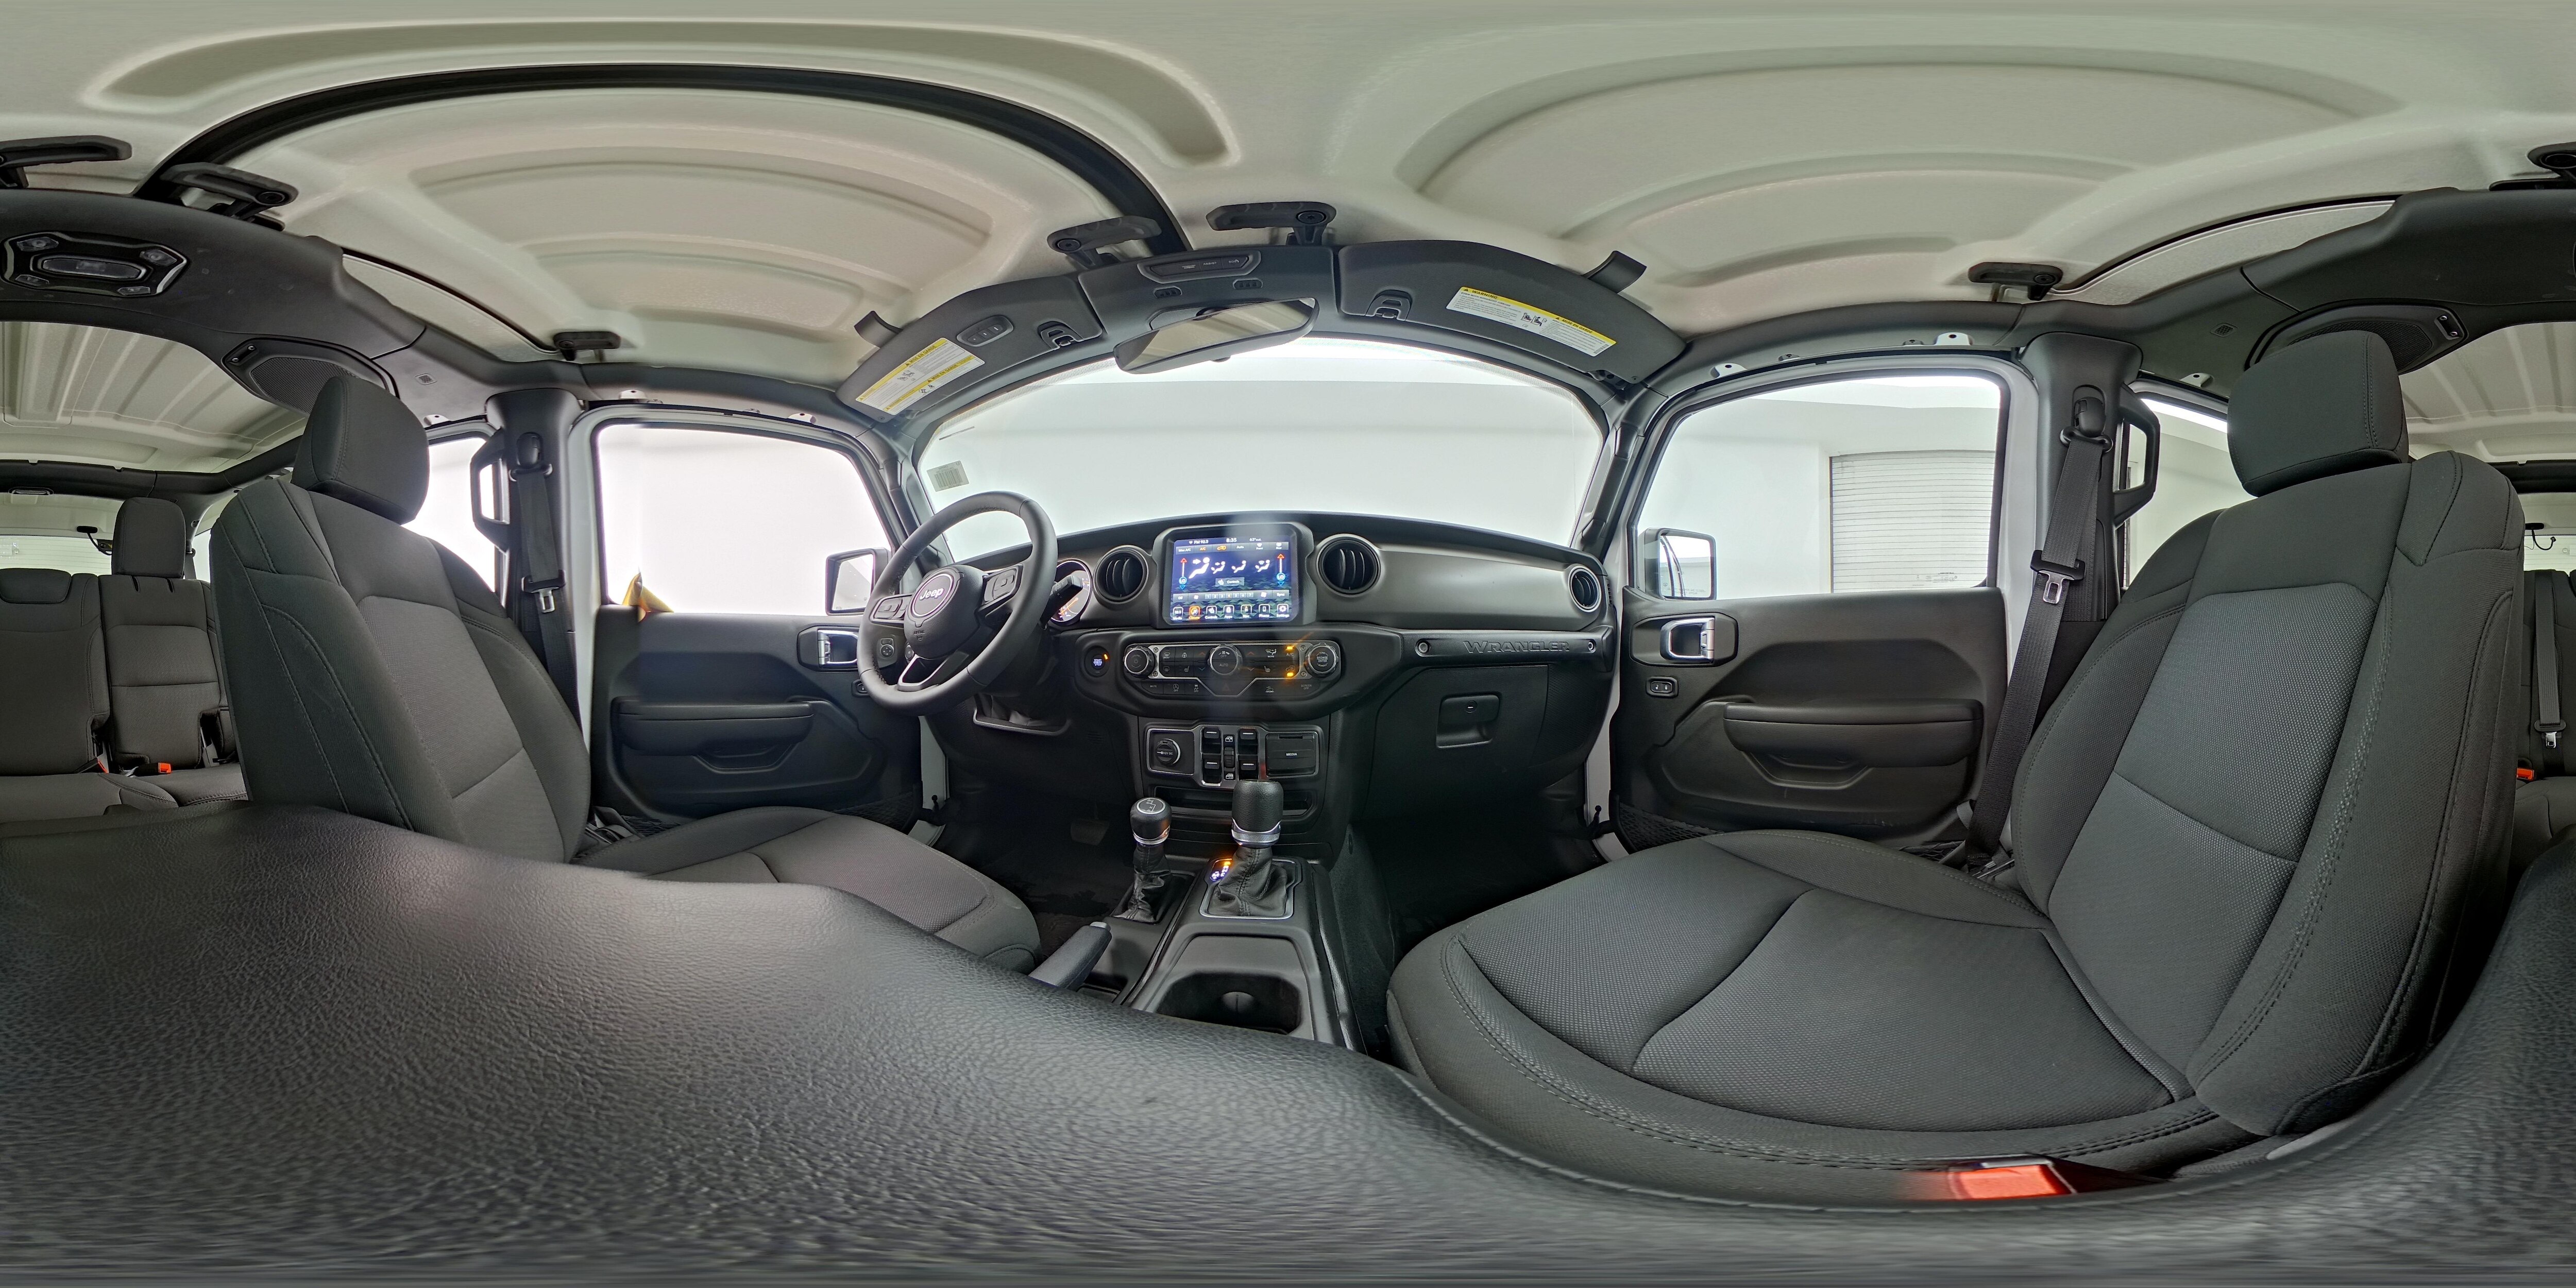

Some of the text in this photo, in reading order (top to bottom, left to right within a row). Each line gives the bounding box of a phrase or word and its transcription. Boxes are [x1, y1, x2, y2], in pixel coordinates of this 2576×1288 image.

[1471, 290, 1498, 299] WARNING
[923, 345, 937, 354] GARDE
[944, 364, 957, 372] GARDE
[920, 588, 944, 600] Jeep
[1463, 640, 1570, 653] WRANGLER
